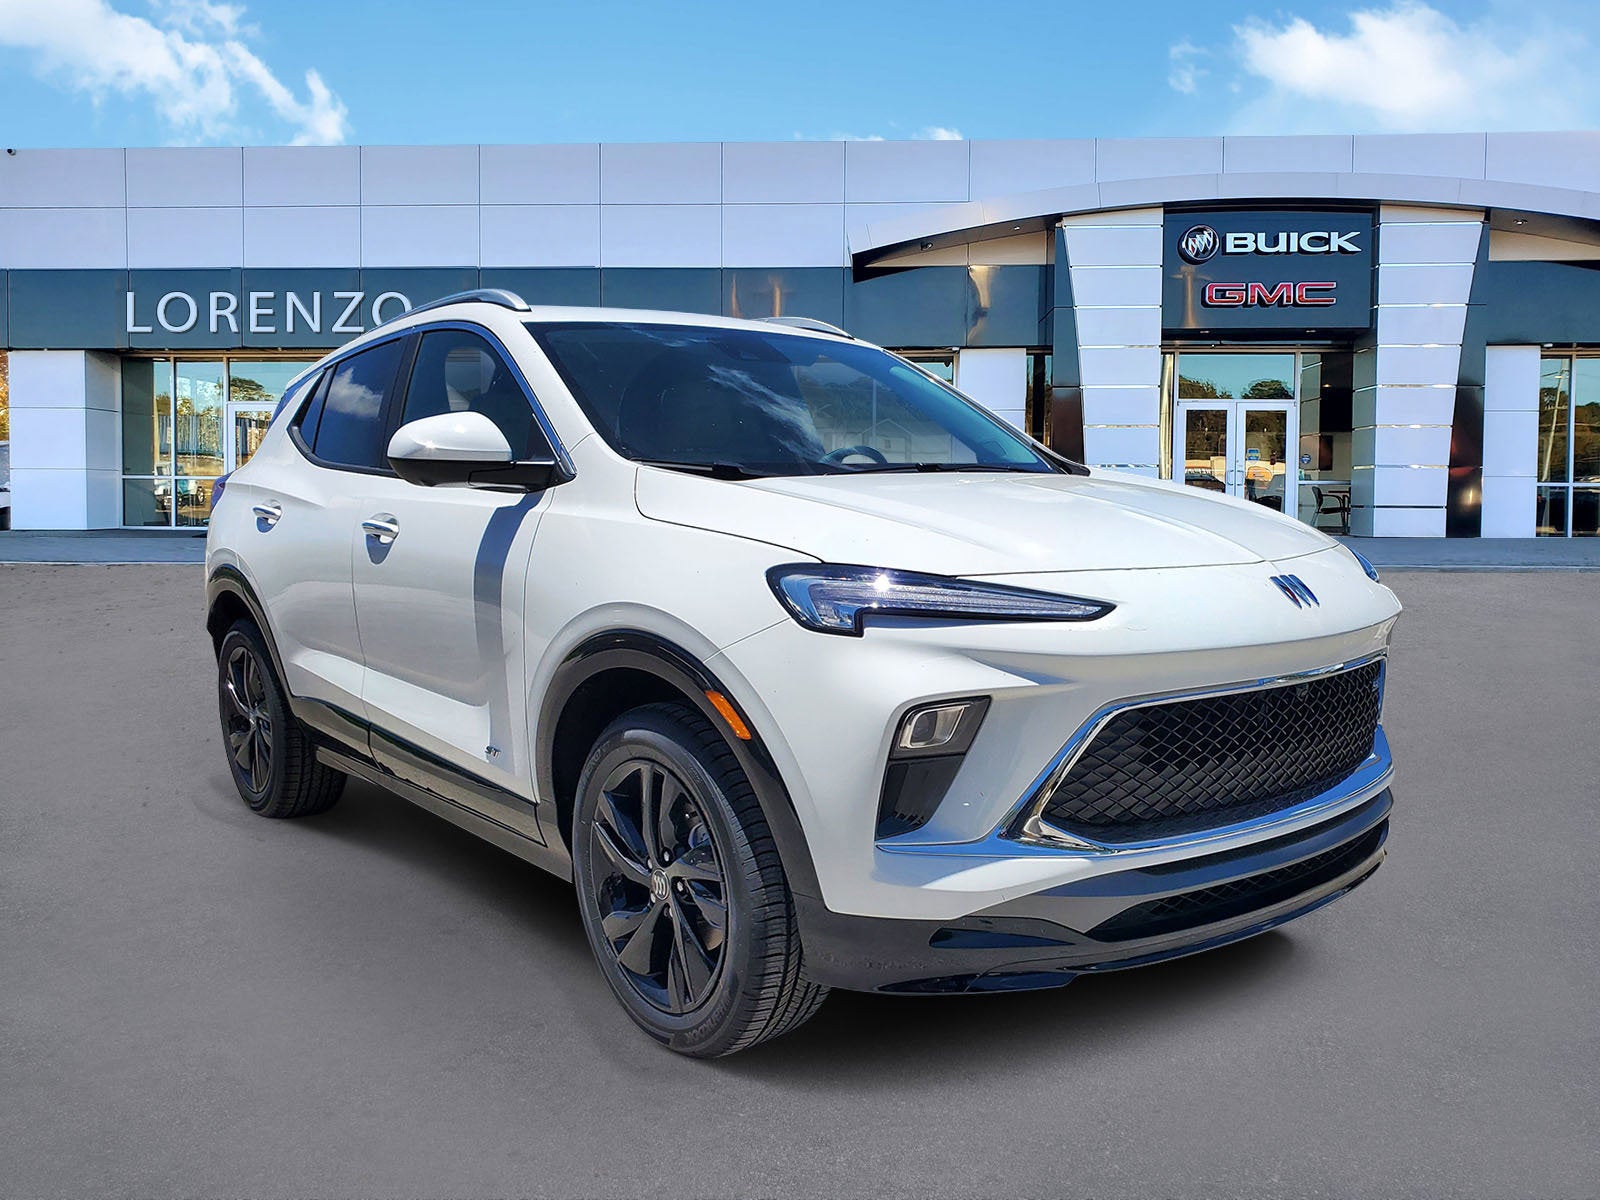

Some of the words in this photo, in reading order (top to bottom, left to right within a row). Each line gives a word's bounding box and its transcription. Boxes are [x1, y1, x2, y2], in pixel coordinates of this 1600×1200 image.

[1225, 231, 1362, 253] BUICK
[1206, 281, 1337, 306] GMC
[126, 291, 412, 333] LORENZO
